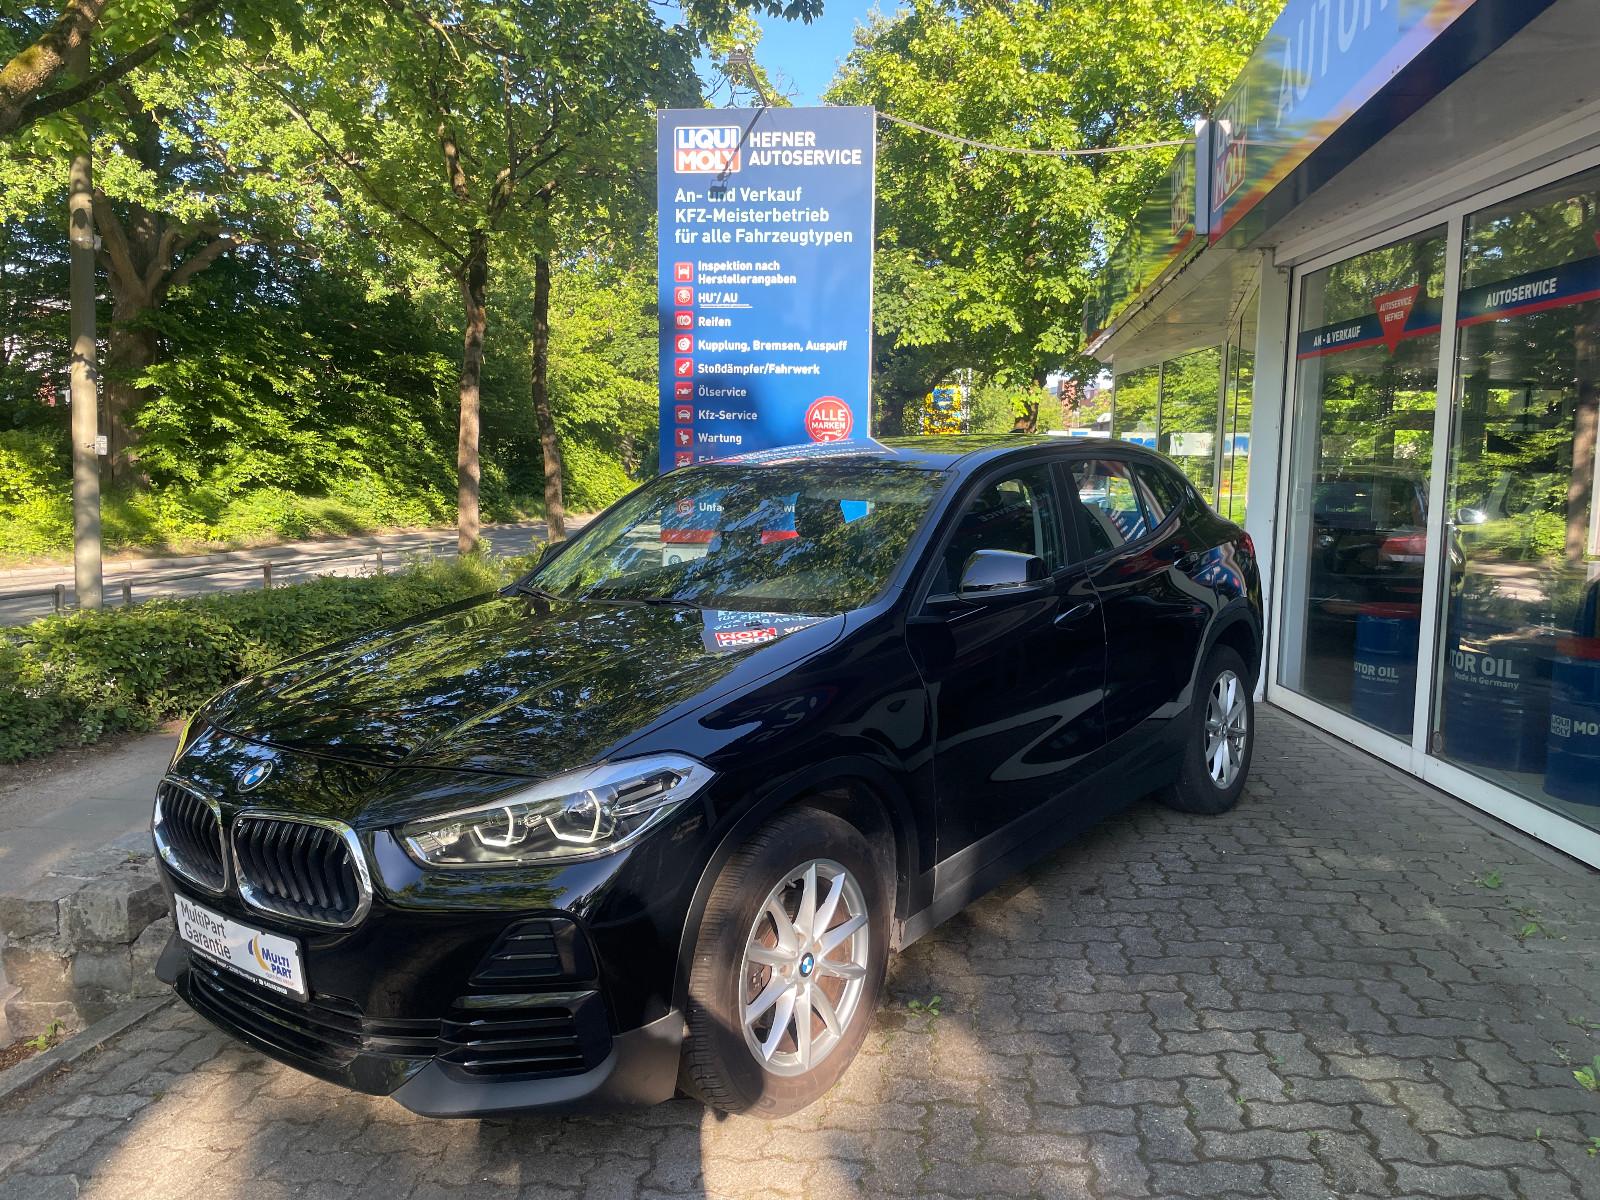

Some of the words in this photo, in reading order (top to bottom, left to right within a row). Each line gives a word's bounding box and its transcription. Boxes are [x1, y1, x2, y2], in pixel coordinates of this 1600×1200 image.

[1275, 0, 1389, 129] AUTO
[678, 129, 737, 149] LIQUI
[749, 132, 816, 147] HEFNER
[678, 151, 736, 171] MOLY
[749, 149, 862, 166] AUTOSERVICE
[1215, 136, 1246, 205] MOLY
[675, 188, 702, 203] An-
[707, 187, 736, 203] und
[740, 187, 802, 202] Verkauf
[675, 208, 829, 223] KFZ-Meisterbetrieb
[675, 229, 700, 244] für
[702, 228, 731, 244] alle
[736, 228, 853, 247] Fahrzeugtypen
[698, 260, 753, 273] Inspektion
[755, 260, 780, 271] nach
[698, 273, 796, 287] Herstellerangaben
[722, 292, 738, 303] AU
[1485, 277, 1558, 309] AUTOSERVICE
[1379, 296, 1412, 312] AUTOSERVICE
[698, 315, 732, 327] Reifen
[1331, 325, 1361, 343] VERKAUF
[698, 340, 750, 353] Kupplung,
[752, 340, 804, 352] Bremsen,
[806, 339, 848, 352] Auspuff
[698, 363, 821, 376] Stoßdämpfer/Fahrwerk
[698, 384, 747, 397] Ölservice
[698, 409, 758, 421] Kfz-Service
[812, 409, 846, 421] ALLE
[811, 421, 846, 430] MARKEN
[698, 432, 742, 445] Wartung
[1378, 666, 1399, 678] OIL
[1481, 656, 1520, 679] OIL
[1478, 676, 1519, 690] Germany
[1574, 720, 1600, 736] MO
[180, 900, 227, 939] MultiPart
[184, 921, 231, 960] Garantie
[261, 947, 290, 969] MULTI
[271, 962, 292, 979] PART
